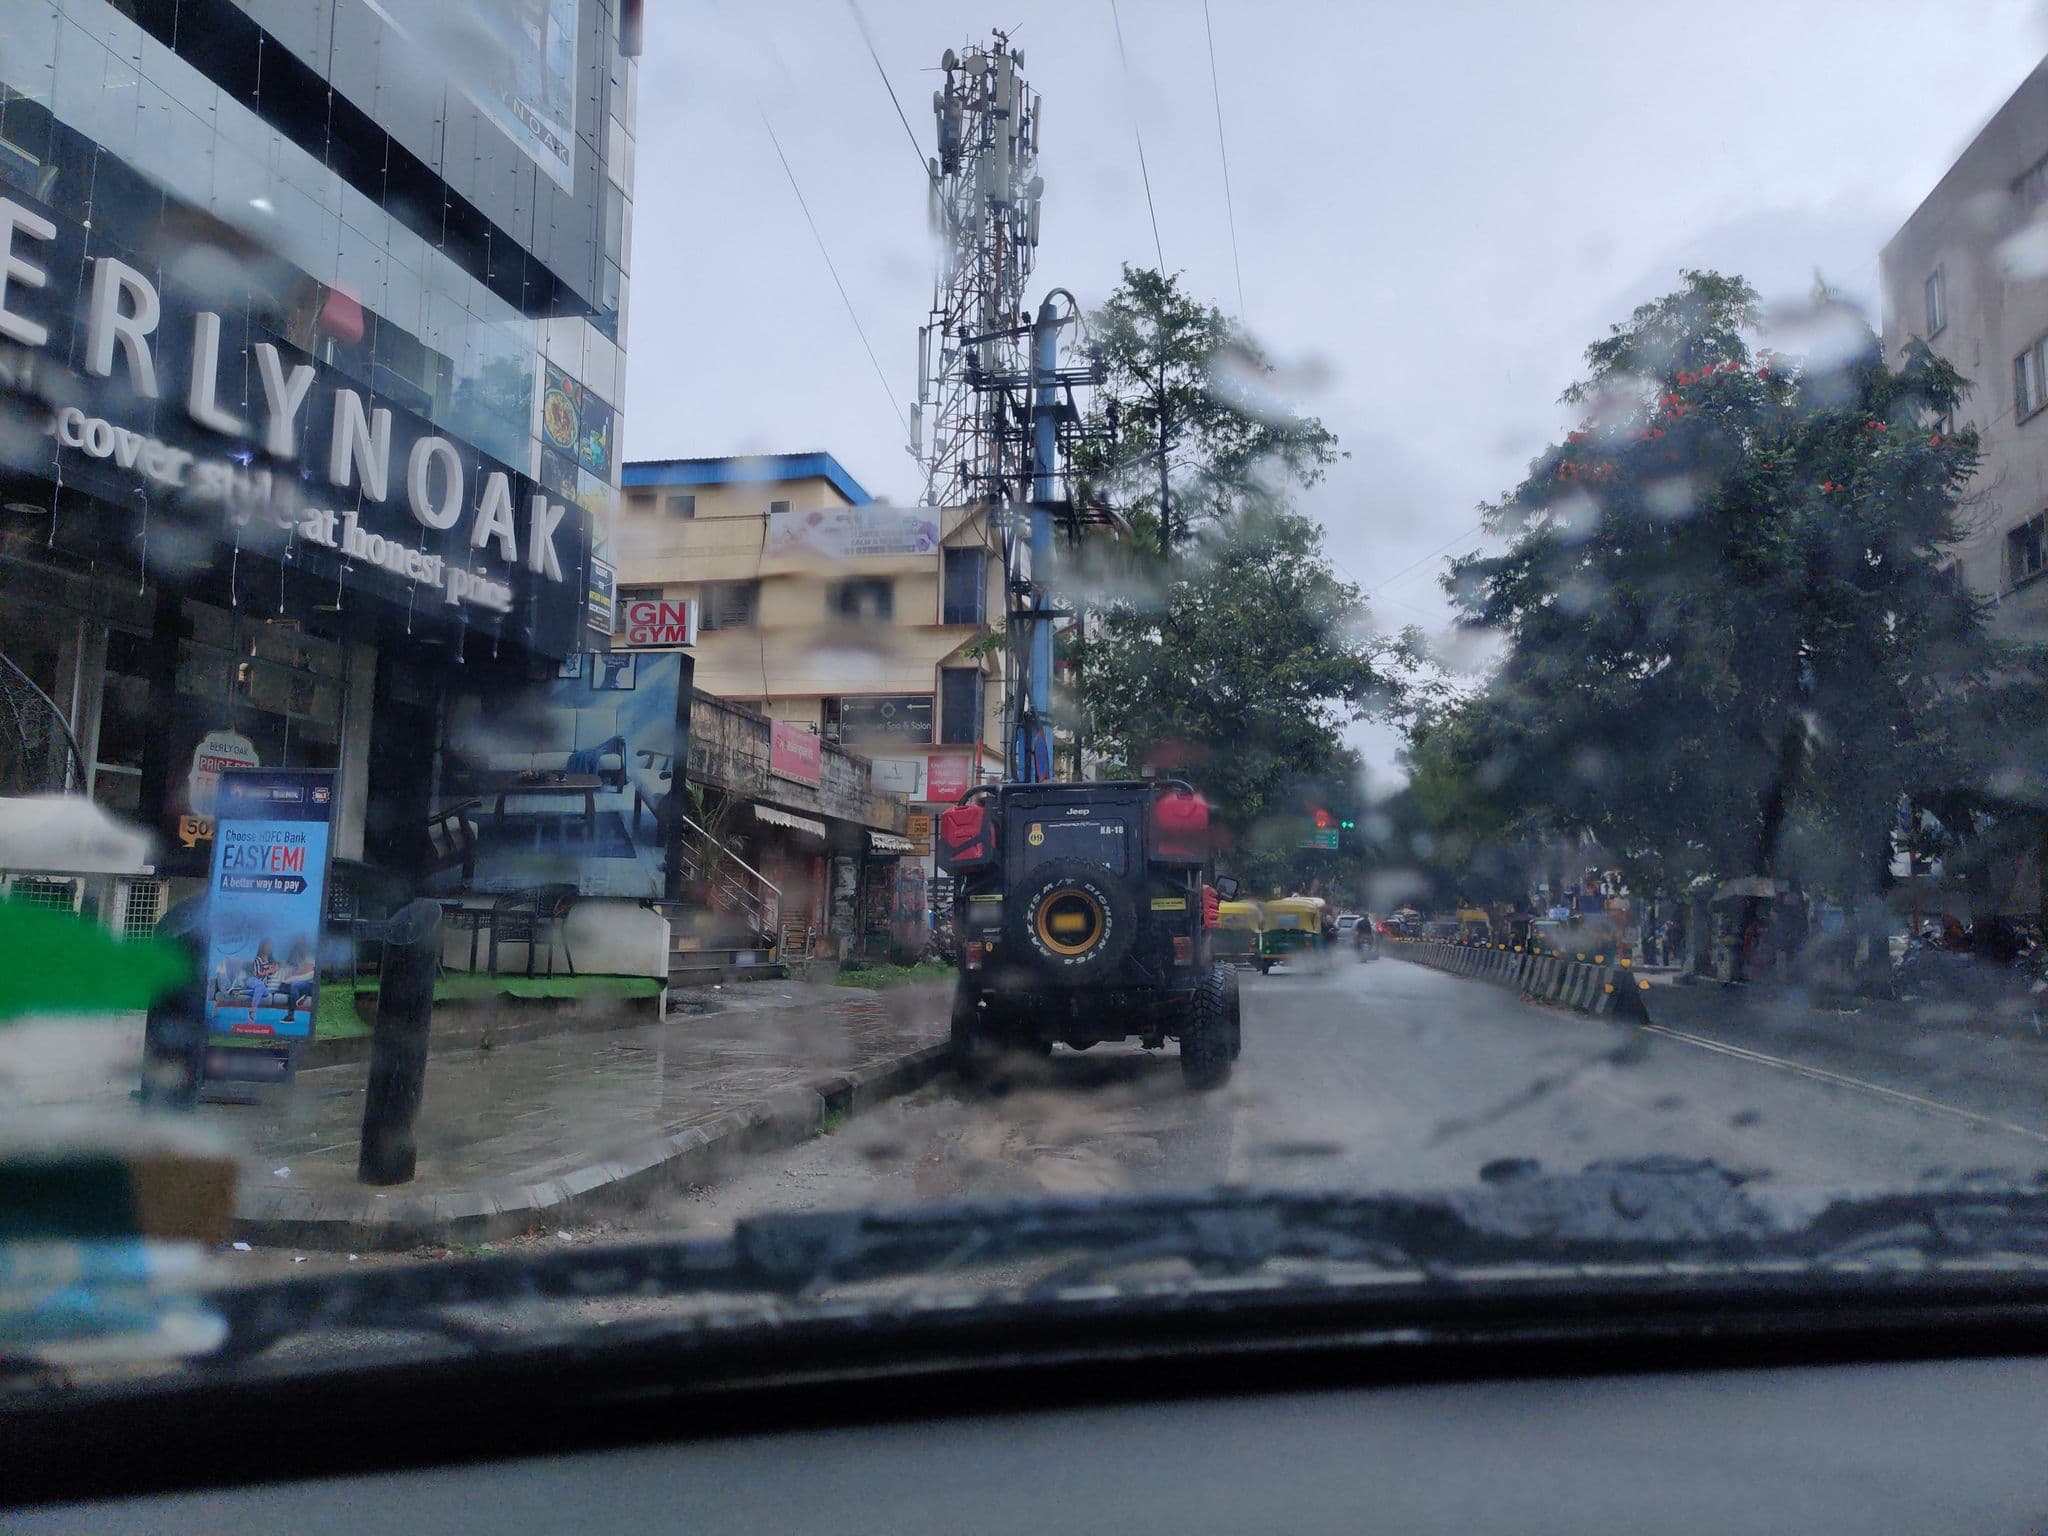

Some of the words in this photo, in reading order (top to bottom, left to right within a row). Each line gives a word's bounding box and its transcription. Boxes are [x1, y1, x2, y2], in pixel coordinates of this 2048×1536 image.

[299, 508, 339, 548] at
[340, 511, 446, 589] honest
[630, 602, 686, 626] GN
[629, 626, 687, 643] GYM
[911, 720, 932, 730] Salon
[1066, 808, 1090, 816] Jeep
[187, 820, 214, 835] 50
[225, 829, 257, 842] Choose
[284, 831, 307, 843] Bank
[222, 844, 306, 873] EASYEMI
[222, 876, 229, 888] A
[230, 876, 254, 889] better
[256, 879, 274, 892] way
[274, 878, 283, 889] to
[284, 880, 300, 893] pay
